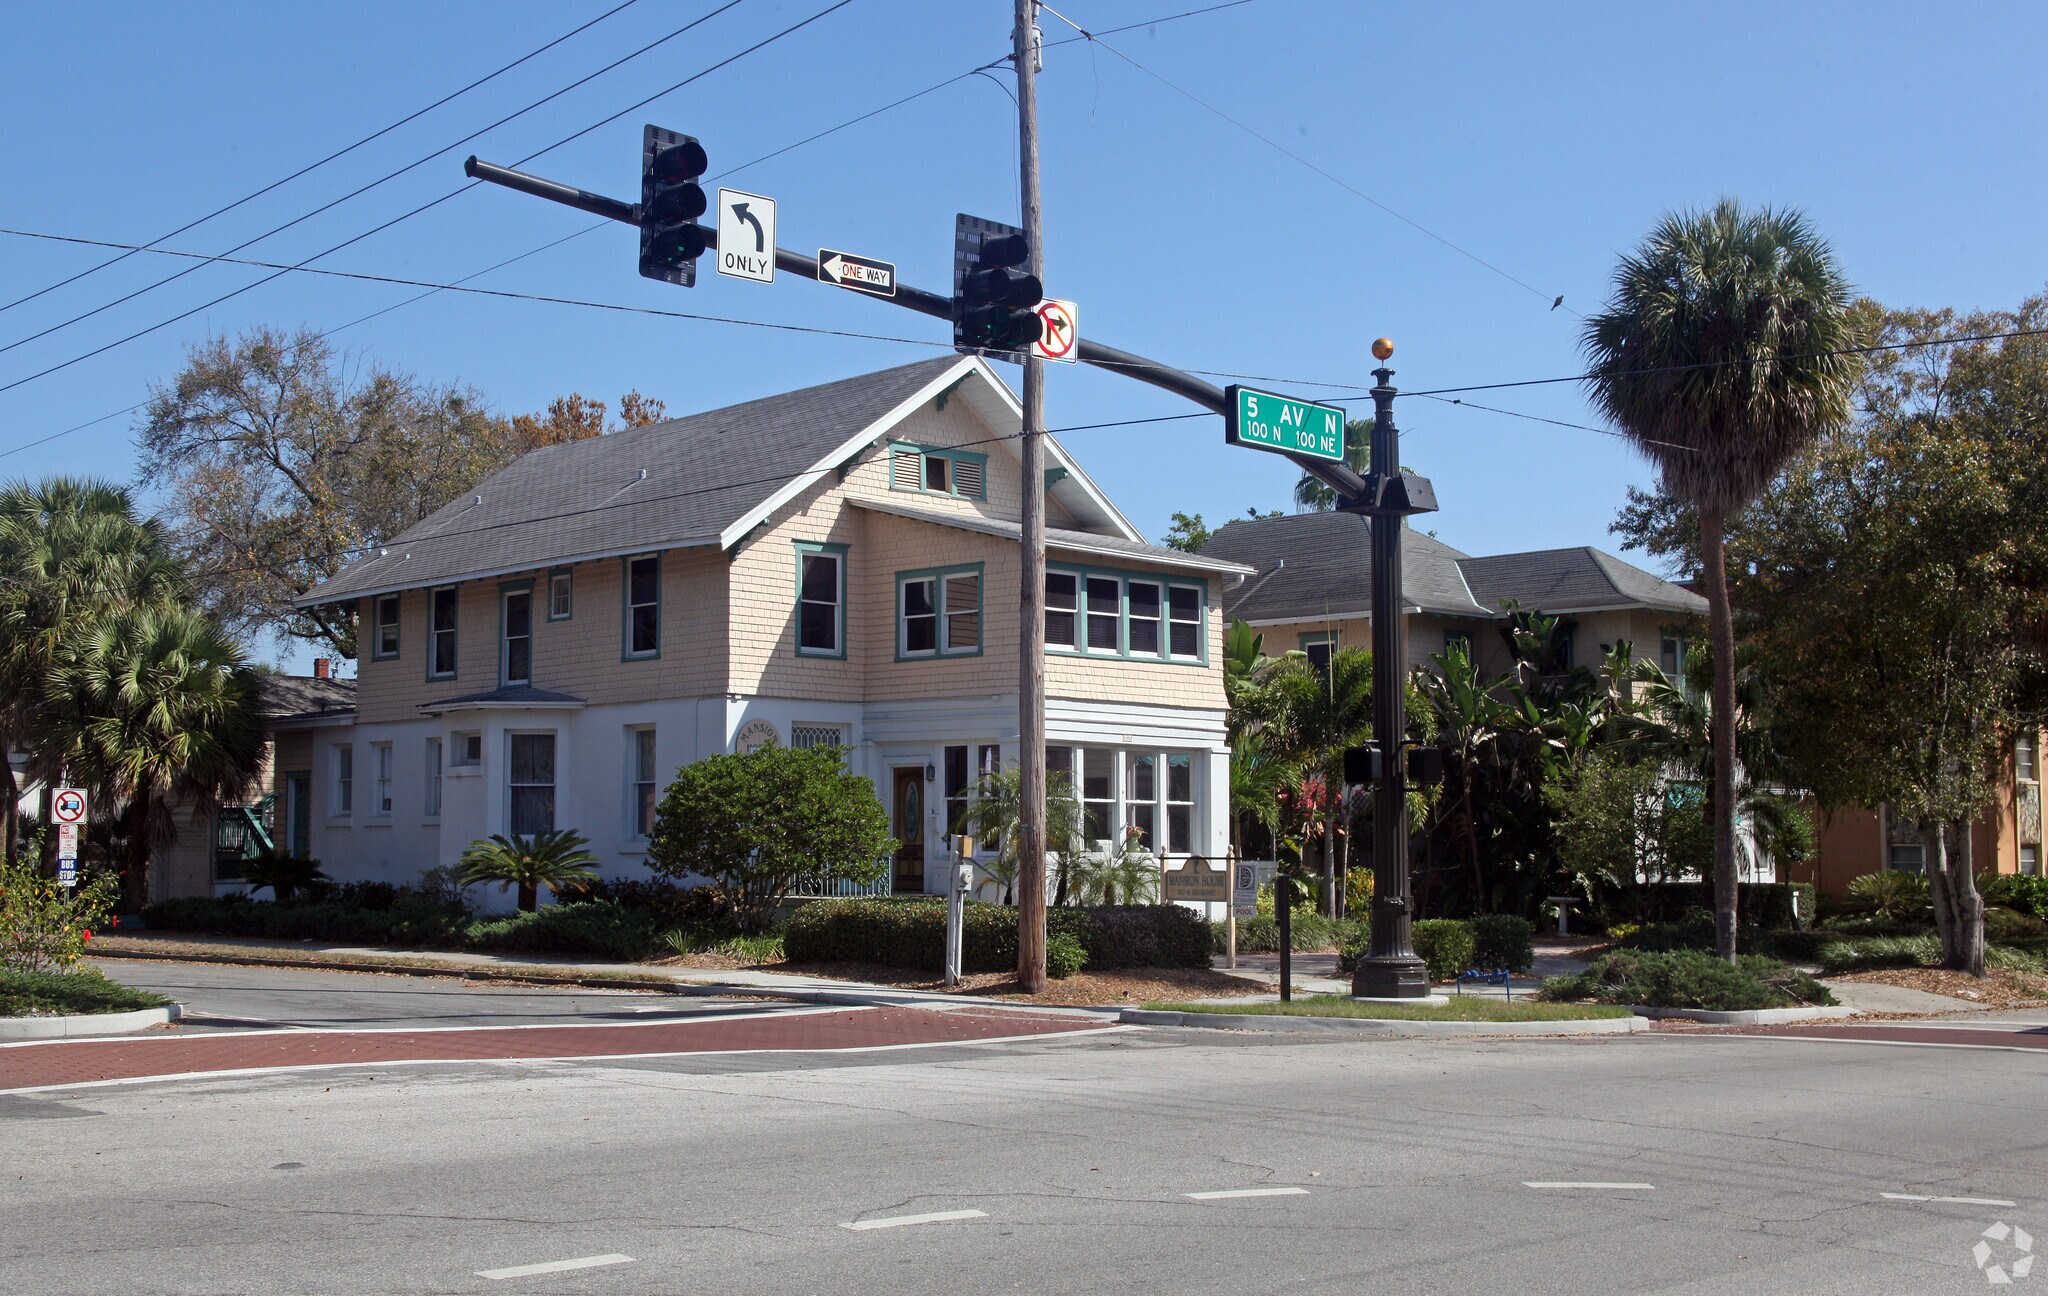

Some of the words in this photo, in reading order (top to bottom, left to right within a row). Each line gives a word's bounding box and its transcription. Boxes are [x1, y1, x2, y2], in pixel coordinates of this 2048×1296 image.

[725, 252, 768, 275] ONLY
[842, 263, 863, 279] ONE
[866, 268, 887, 284] WAY
[1247, 396, 1259, 418] 5
[1279, 404, 1304, 427] AV
[1325, 413, 1336, 435] N
[1247, 420, 1268, 439] 100
[1273, 425, 1281, 442] N
[1296, 430, 1316, 449] 100
[1320, 435, 1336, 453] NE
[741, 723, 778, 742] MANSION
[61, 860, 74, 869] BUS
[60, 870, 76, 880] STOP
[1169, 875, 1200, 887] MANSION
[1201, 875, 1225, 887] HOUSE
